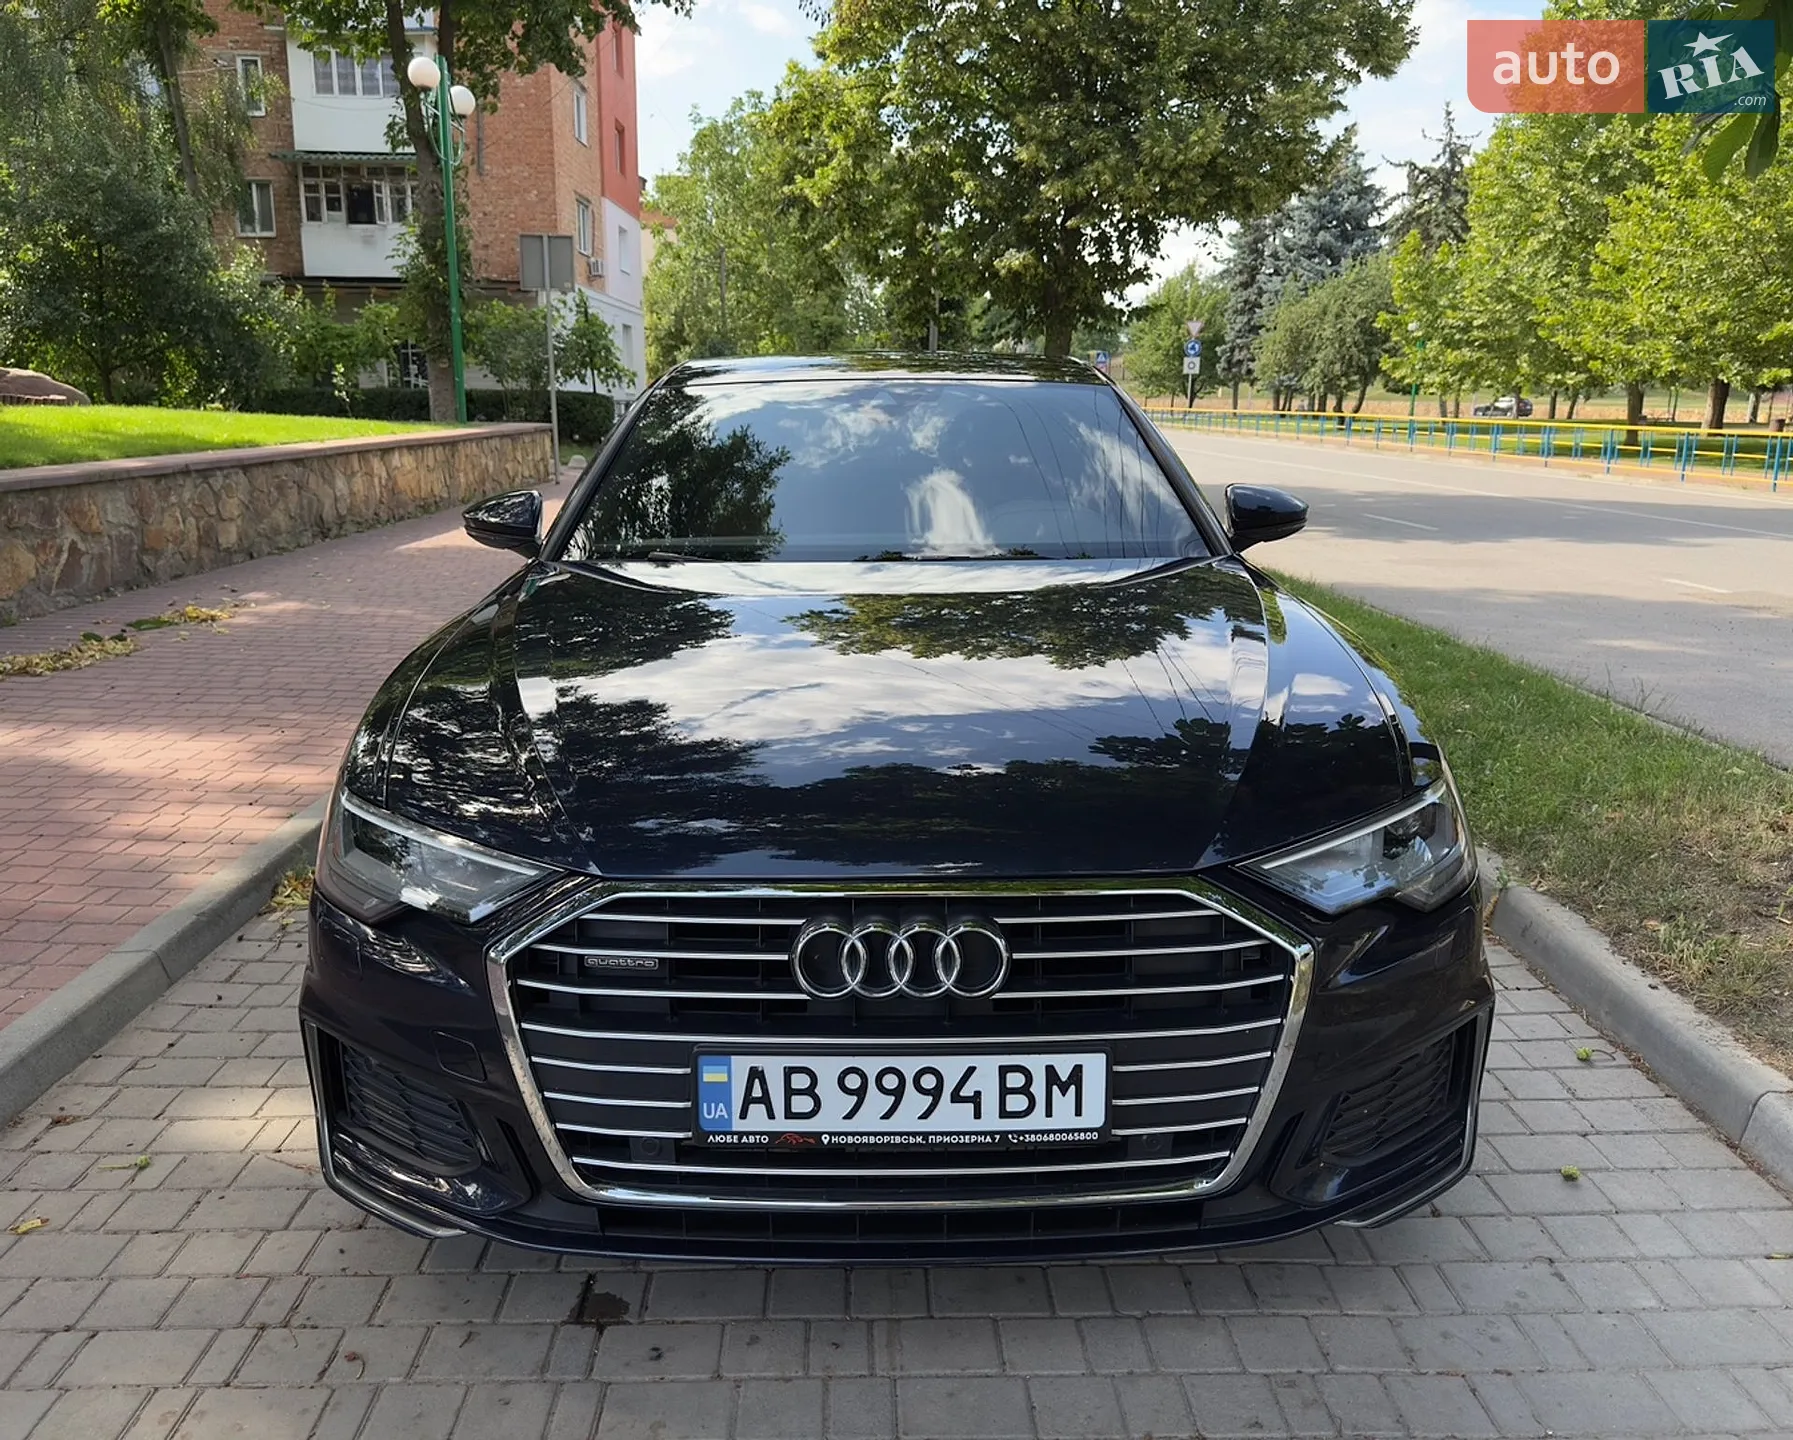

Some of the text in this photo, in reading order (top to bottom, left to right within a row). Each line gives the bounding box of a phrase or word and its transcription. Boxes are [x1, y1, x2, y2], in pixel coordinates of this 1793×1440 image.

[587, 957, 655, 967] quattro
[738, 1063, 1084, 1121] AB 9994 BM
[702, 1101, 729, 1120] UA
[707, 1134, 739, 1144] ЛЮБЕ
[740, 1135, 769, 1144] АВТО
[928, 1135, 992, 1144] ПРИОЗЕРНА
[994, 1134, 1000, 1143] 7
